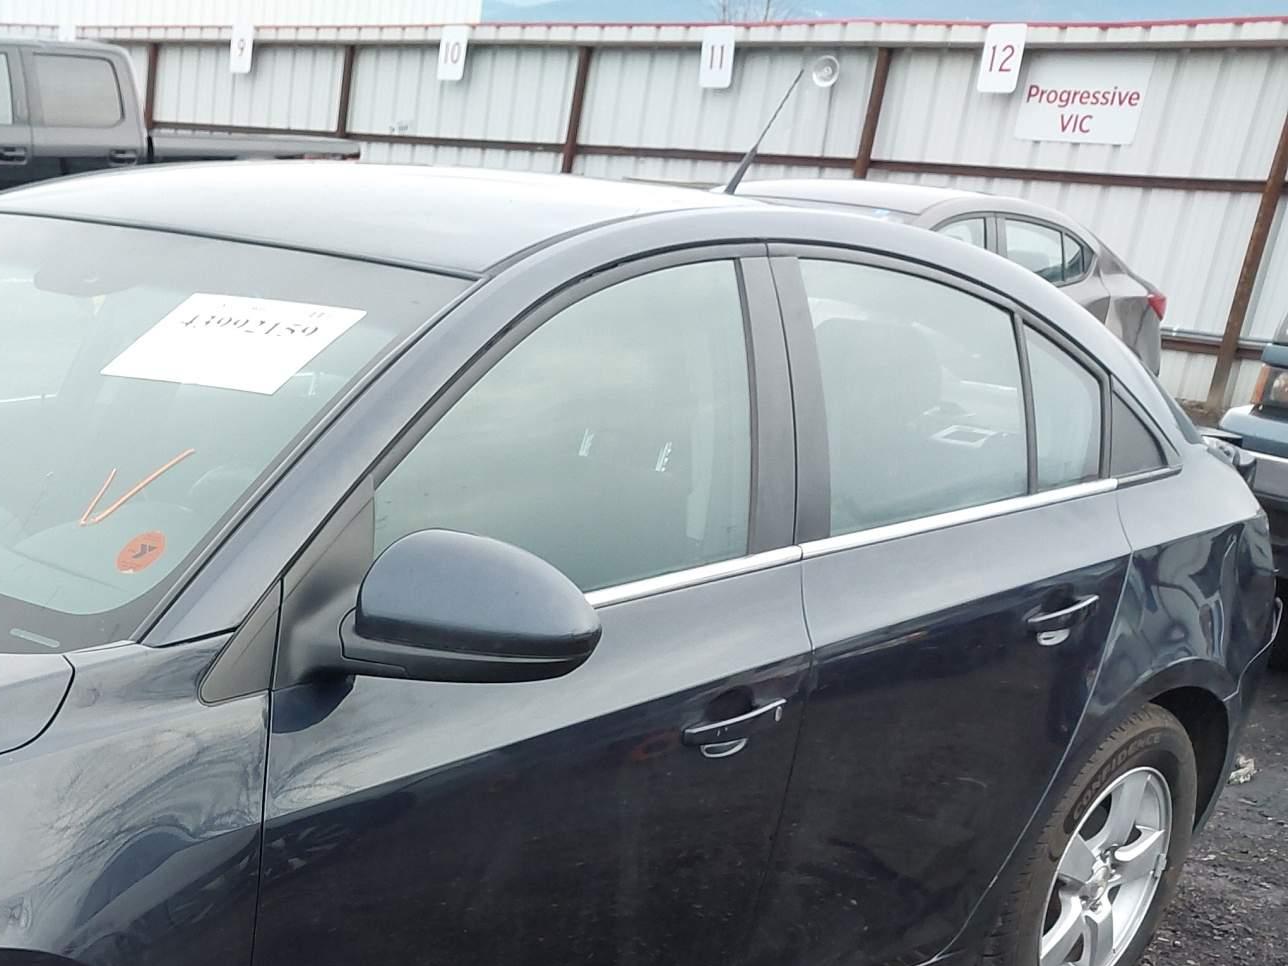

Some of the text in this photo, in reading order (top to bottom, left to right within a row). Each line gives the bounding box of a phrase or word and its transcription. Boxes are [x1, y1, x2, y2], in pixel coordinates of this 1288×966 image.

[443, 42, 462, 64] 10
[709, 45, 725, 70] 11
[988, 44, 1015, 72] 12
[1026, 84, 1141, 108] Progressive
[1060, 113, 1094, 133] VIC
